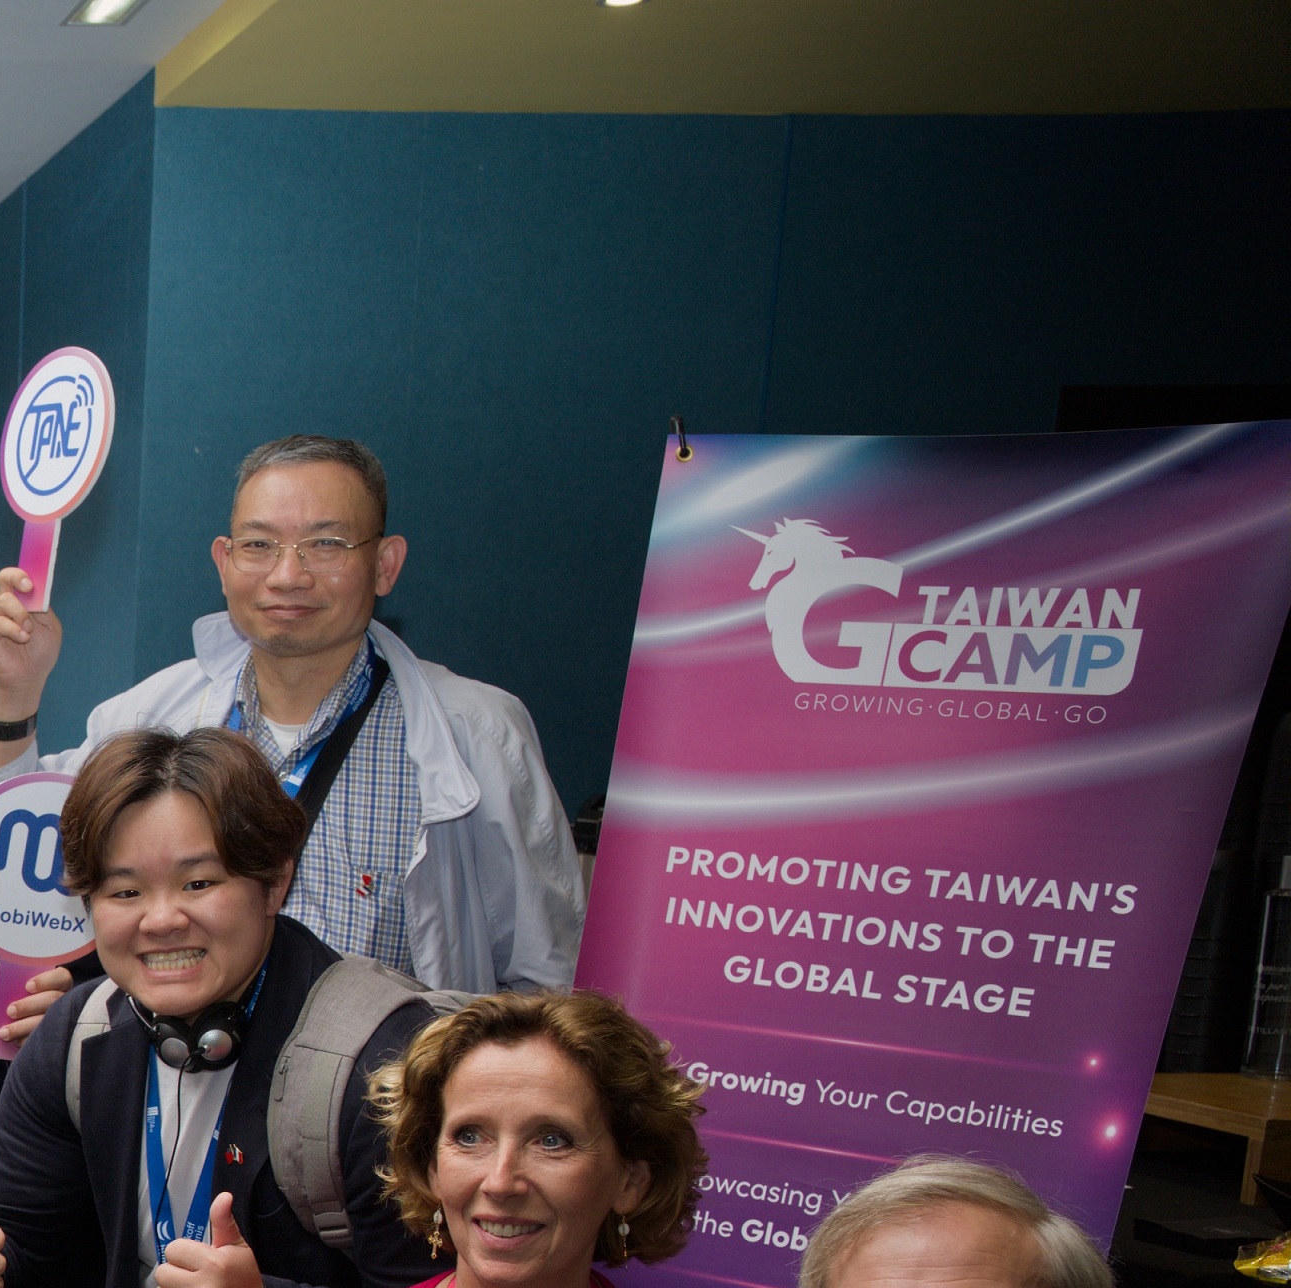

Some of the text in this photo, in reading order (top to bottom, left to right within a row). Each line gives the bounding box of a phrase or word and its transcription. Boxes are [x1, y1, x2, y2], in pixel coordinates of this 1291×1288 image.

[917, 585, 1141, 629] TAIWAN
[898, 629, 1125, 688] CAMP
[665, 845, 1138, 915] PROMOTING TAIWAN'S
[665, 896, 1116, 970] INNOVATIONS TO THE
[723, 955, 1035, 1018] GLOBAL STAGE
[686, 1062, 1064, 1137] Growing Your Capabilities
[697, 1174, 823, 1216] owcasing
[692, 1210, 808, 1252] the Glob
